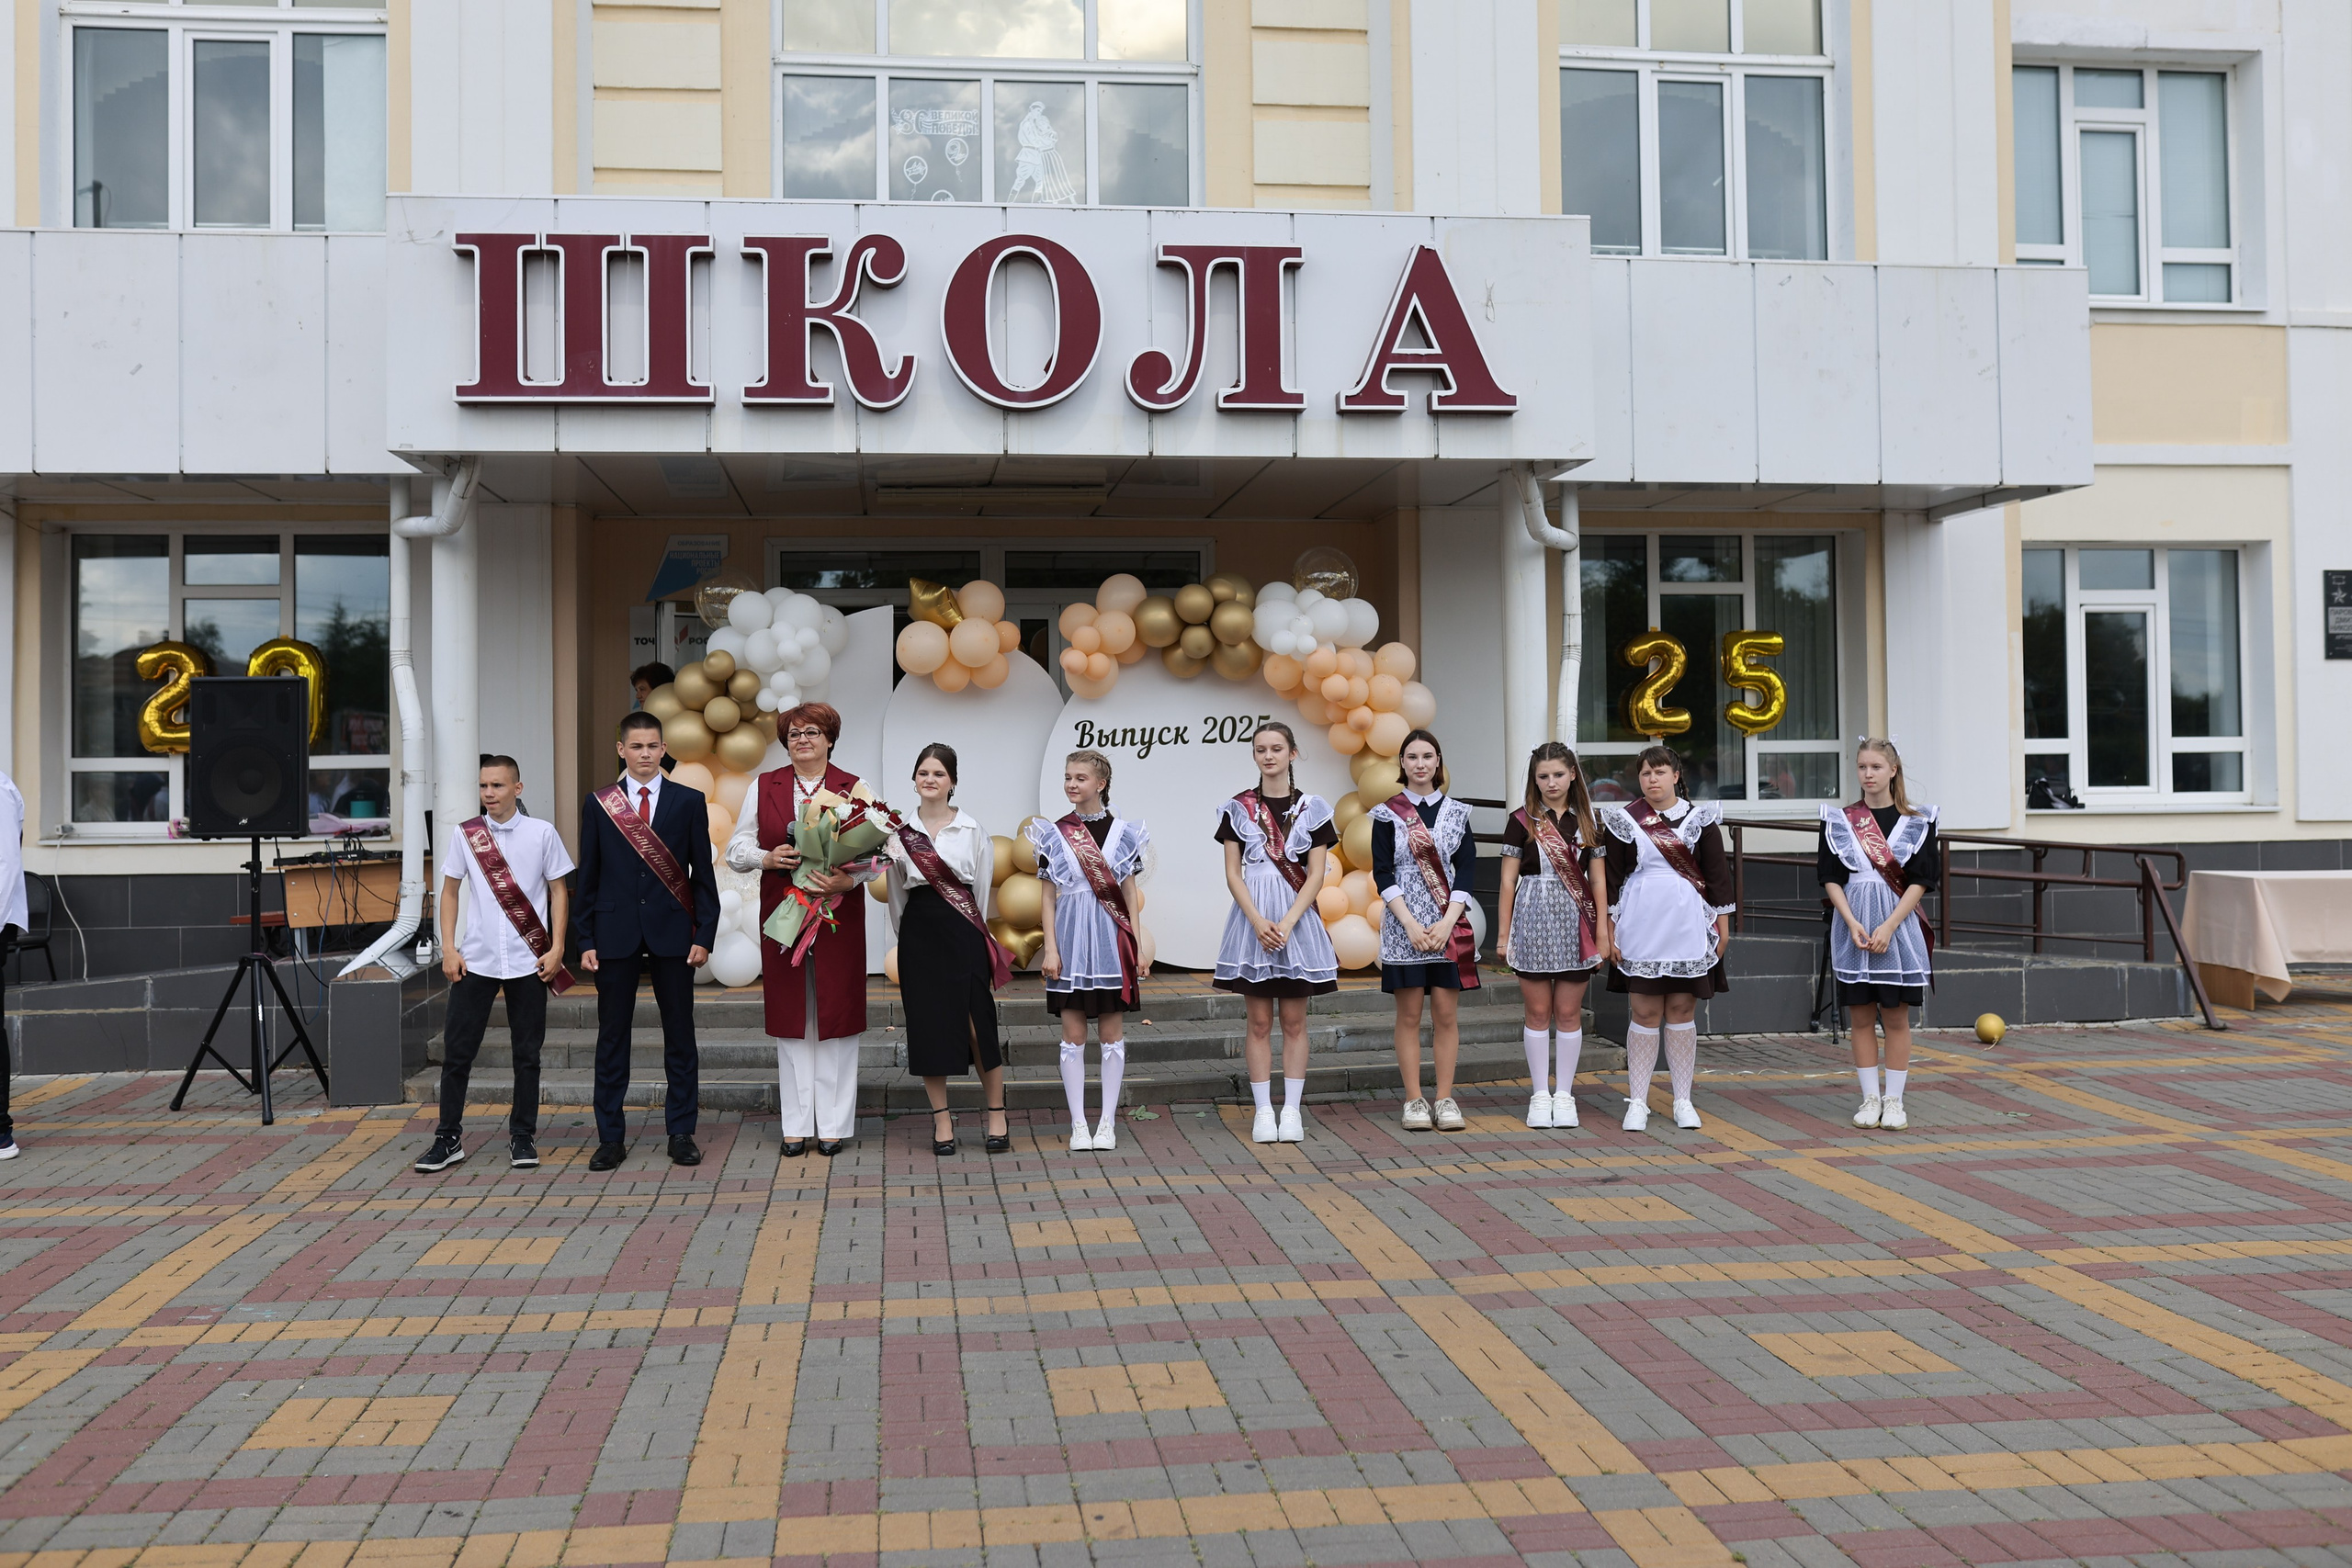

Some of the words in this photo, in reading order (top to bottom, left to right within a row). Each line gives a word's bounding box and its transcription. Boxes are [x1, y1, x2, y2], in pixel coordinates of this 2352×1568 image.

[931, 110, 978, 121] ВЕЛИКОЙ
[451, 231, 1521, 415] ШКОЛА
[669, 551, 720, 559] НАЦИОНАЛЬНЫЕ
[1074, 720, 1190, 760] Выпуск
[621, 811, 674, 880] Выпускник
[910, 843, 964, 902] Выпускница
[483, 852, 528, 924] Выпускник
